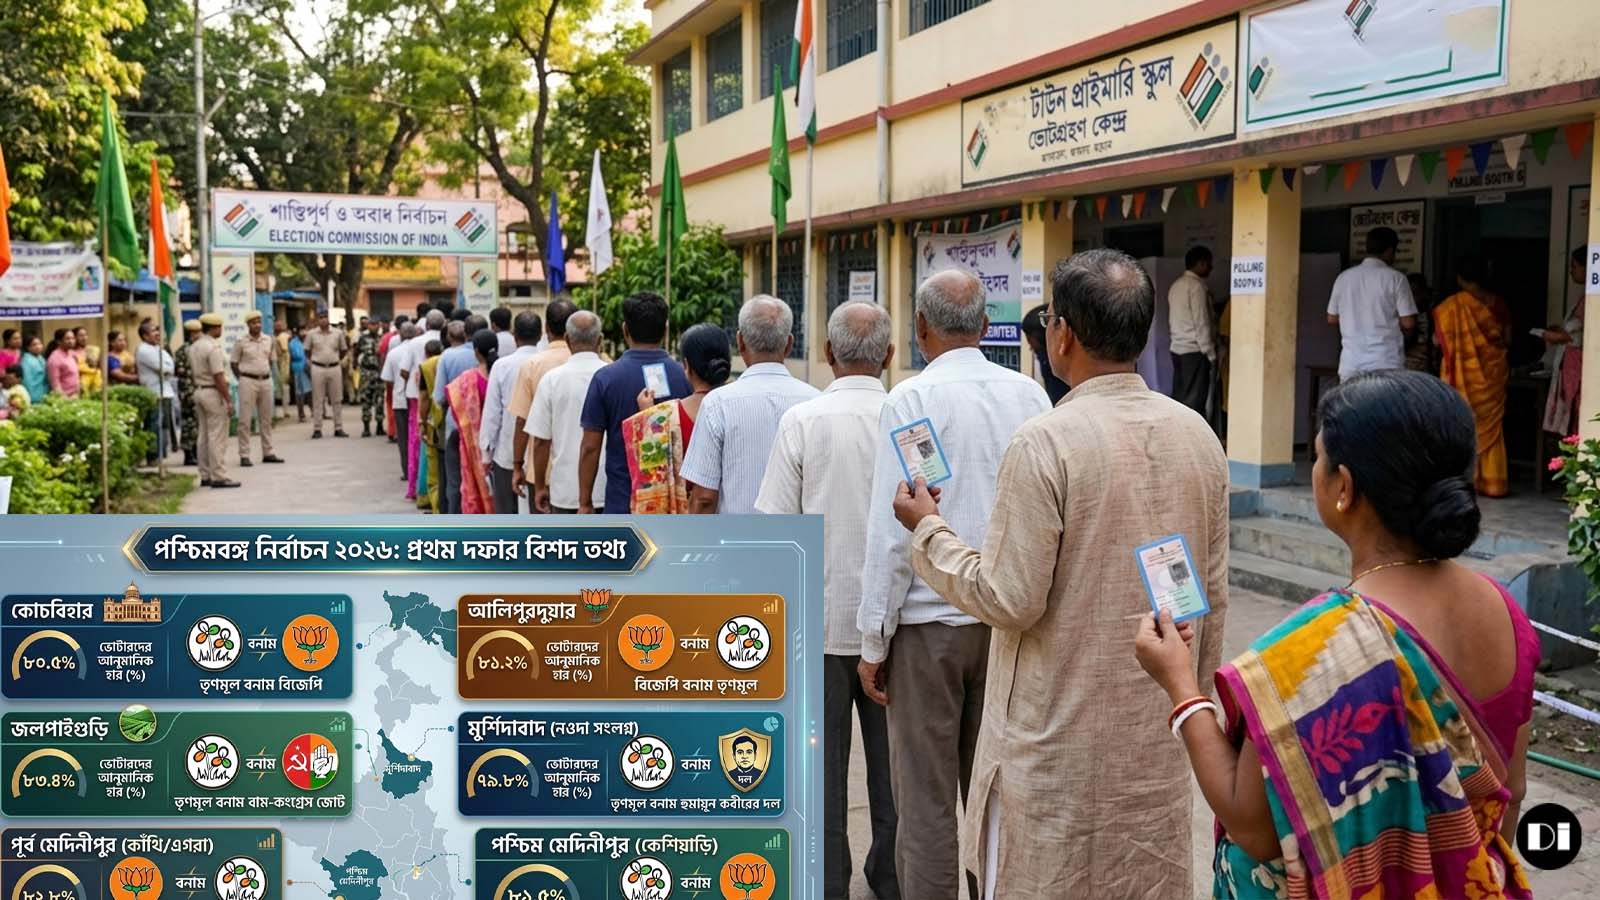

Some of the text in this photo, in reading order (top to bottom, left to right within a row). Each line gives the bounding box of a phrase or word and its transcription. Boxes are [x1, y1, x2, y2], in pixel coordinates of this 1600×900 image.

[1030, 56, 1174, 119] টাউন প্রাইমারি স্কুল
[269, 229, 448, 246] ELECTION COMMISSION OF INDIA
